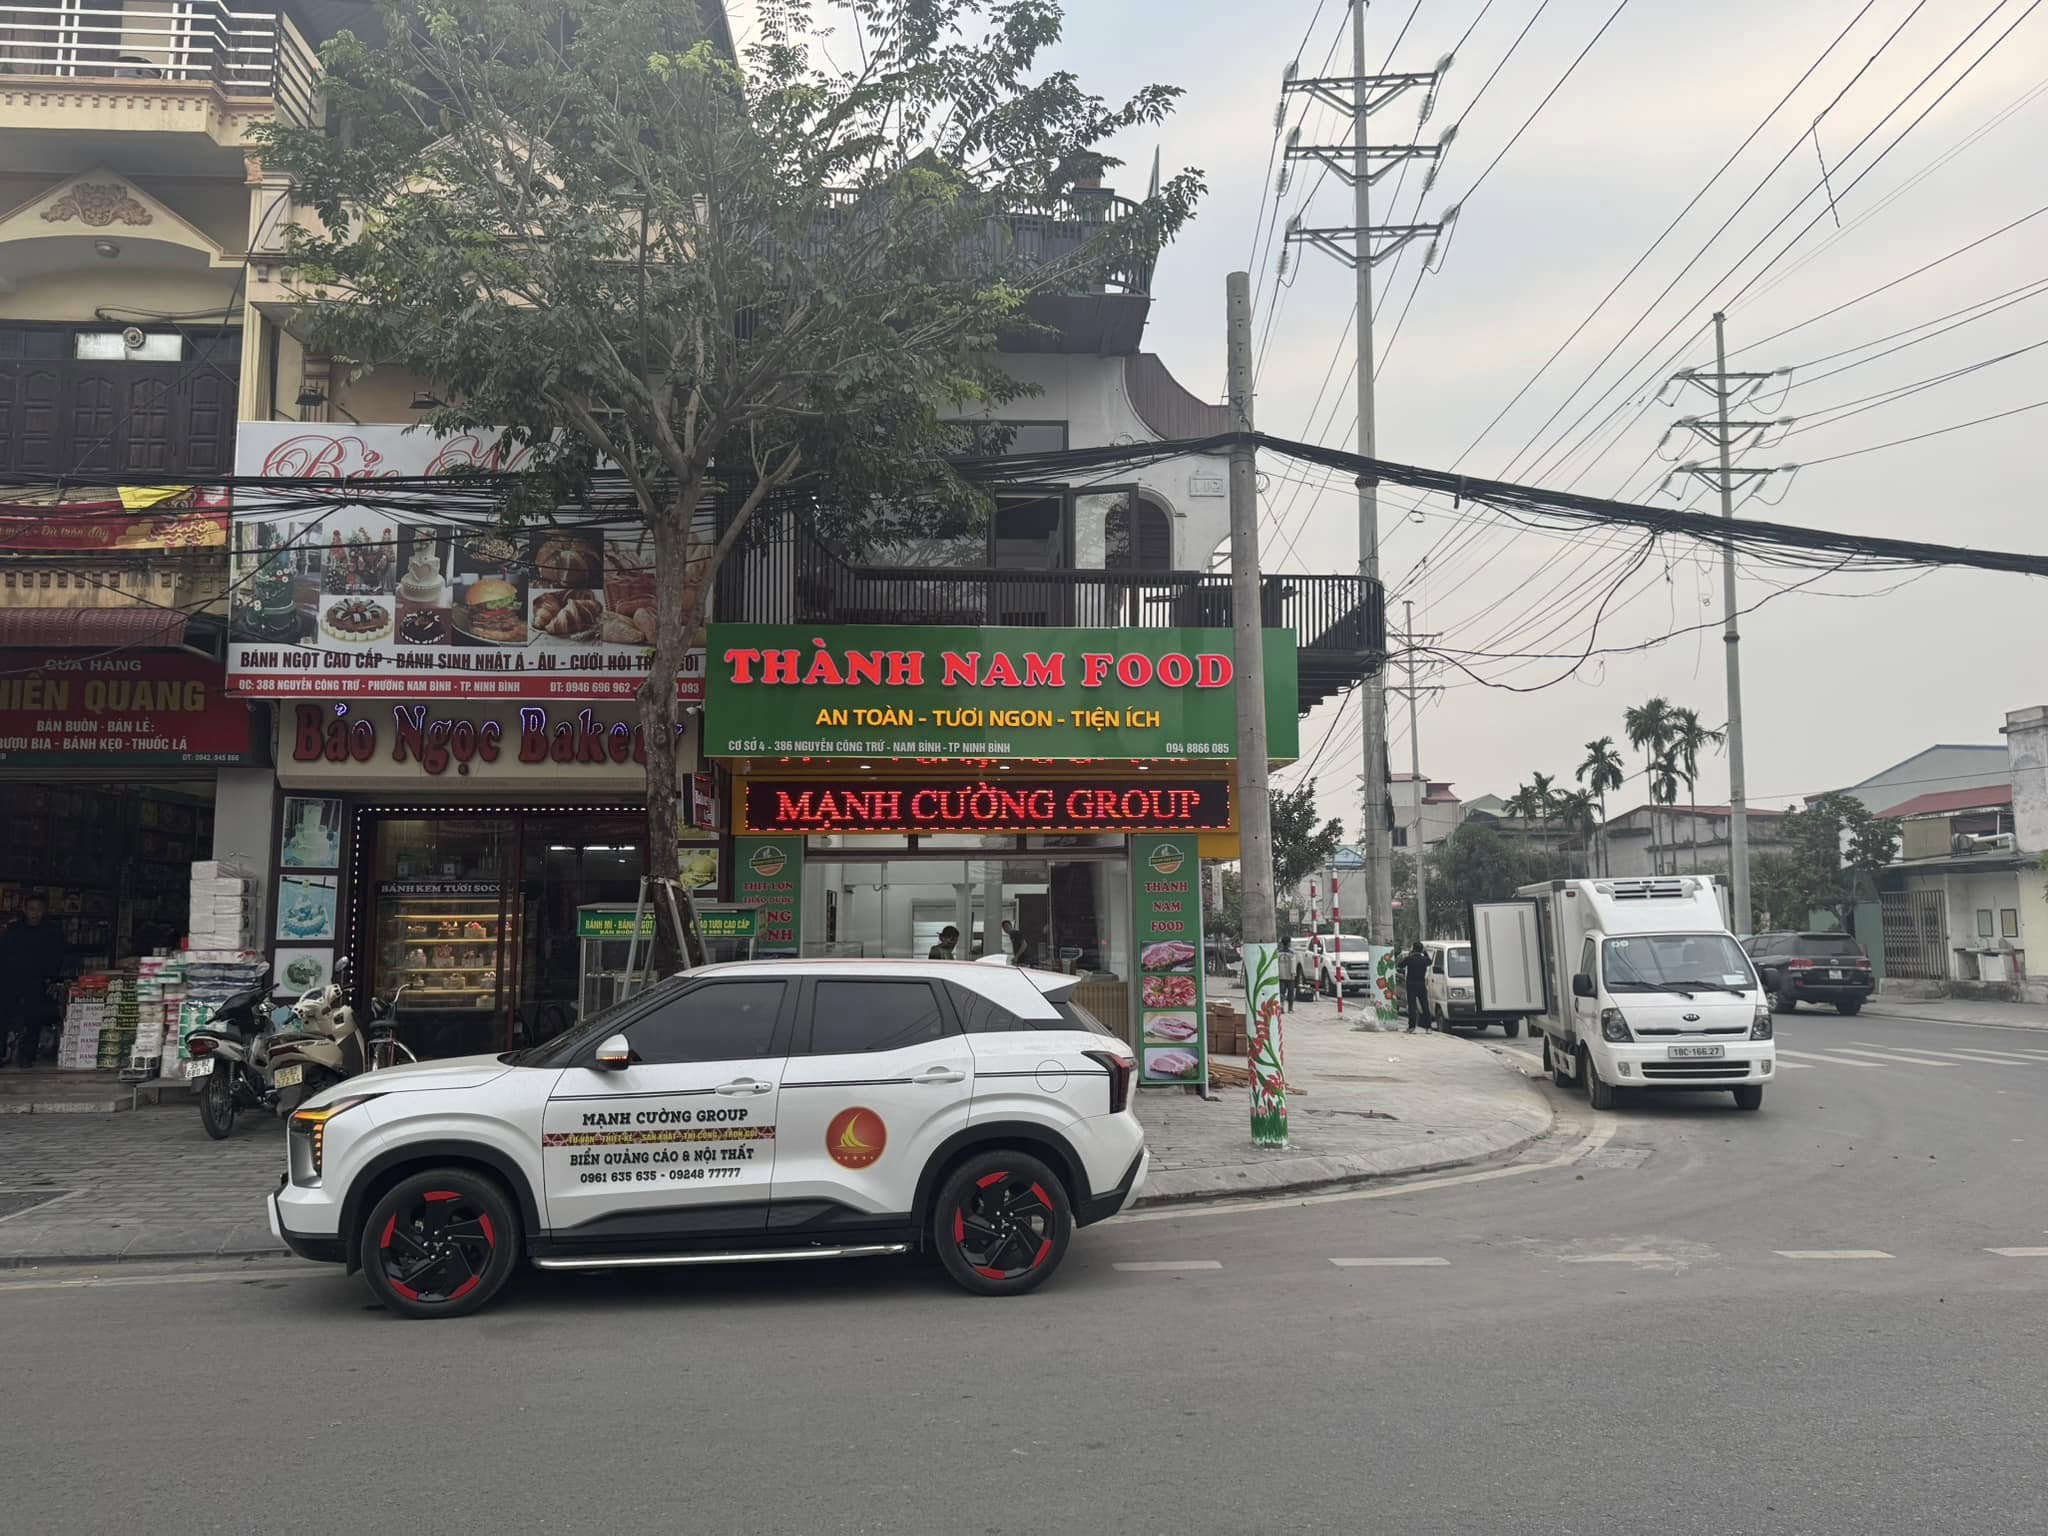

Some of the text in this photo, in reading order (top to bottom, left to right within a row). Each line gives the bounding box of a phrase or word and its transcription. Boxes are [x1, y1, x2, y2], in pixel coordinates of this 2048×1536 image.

[90, 656, 142, 671] HÀNG
[240, 649, 280, 668] BÁNH
[283, 652, 320, 671] NGỌT
[324, 652, 351, 669] CAO
[356, 648, 383, 669] CẤP
[396, 650, 434, 669] BÁNH
[438, 653, 471, 670] SINH
[608, 651, 632, 671] HỎI
[724, 638, 1234, 689] THÀNH NAM FOOD
[257, 680, 275, 690] 388
[315, 678, 339, 691] CÔNG
[407, 681, 427, 691] NAM
[429, 680, 452, 692] BÌNH
[474, 682, 496, 692] NINH
[498, 680, 520, 692] BÌNH
[566, 682, 589, 693] 0946
[592, 682, 610, 693] 696
[613, 682, 631, 693] 962
[681, 683, 700, 693] 093
[85, 680, 206, 714] QUANG
[37, 719, 62, 732] BÁN
[65, 719, 98, 732] BUÔN
[108, 719, 132, 732] BÁN
[816, 709, 848, 726] AN
[853, 705, 913, 726] TOÀN
[932, 707, 983, 727] TƯƠI
[989, 709, 1052, 728] NGON
[1071, 706, 1120, 731] TIỆN
[1126, 706, 1160, 728] ÍCH
[31, 737, 52, 750] BIA
[63, 736, 96, 750] BÁNH
[100, 738, 123, 752] KẸO
[173, 736, 188, 751] LÁ
[293, 703, 684, 775] Bảo Ngọc Baker
[759, 741, 765, 752] 4
[774, 740, 793, 751] 386
[836, 739, 863, 752] CÔNG
[893, 742, 916, 752] NAM
[918, 740, 941, 752] BÌNH
[949, 742, 960, 753] TP
[962, 743, 985, 753] NINH
[988, 740, 1010, 753] BÌNH
[1166, 742, 1184, 753] 094
[1212, 743, 1229, 753] 085
[775, 781, 1201, 828] MẠNH CƯỜNG GROUP
[381, 882, 414, 893] BÁNH
[416, 884, 441, 893] KEM
[1145, 879, 1187, 892] THÀNH
[1153, 902, 1181, 912] NAM
[1151, 921, 1184, 932] FOOD
[582, 1108, 748, 1129] MẠNH CƯỜNG GROUP
[570, 1144, 754, 1166] BIỂN QUẢNG CÁO & NỘI THẤT
[580, 1172, 607, 1183] 0961
[611, 1171, 632, 1182] 635
[636, 1170, 657, 1181] 635
[669, 1168, 704, 1180] 09248
[708, 1167, 741, 1178] 77777
